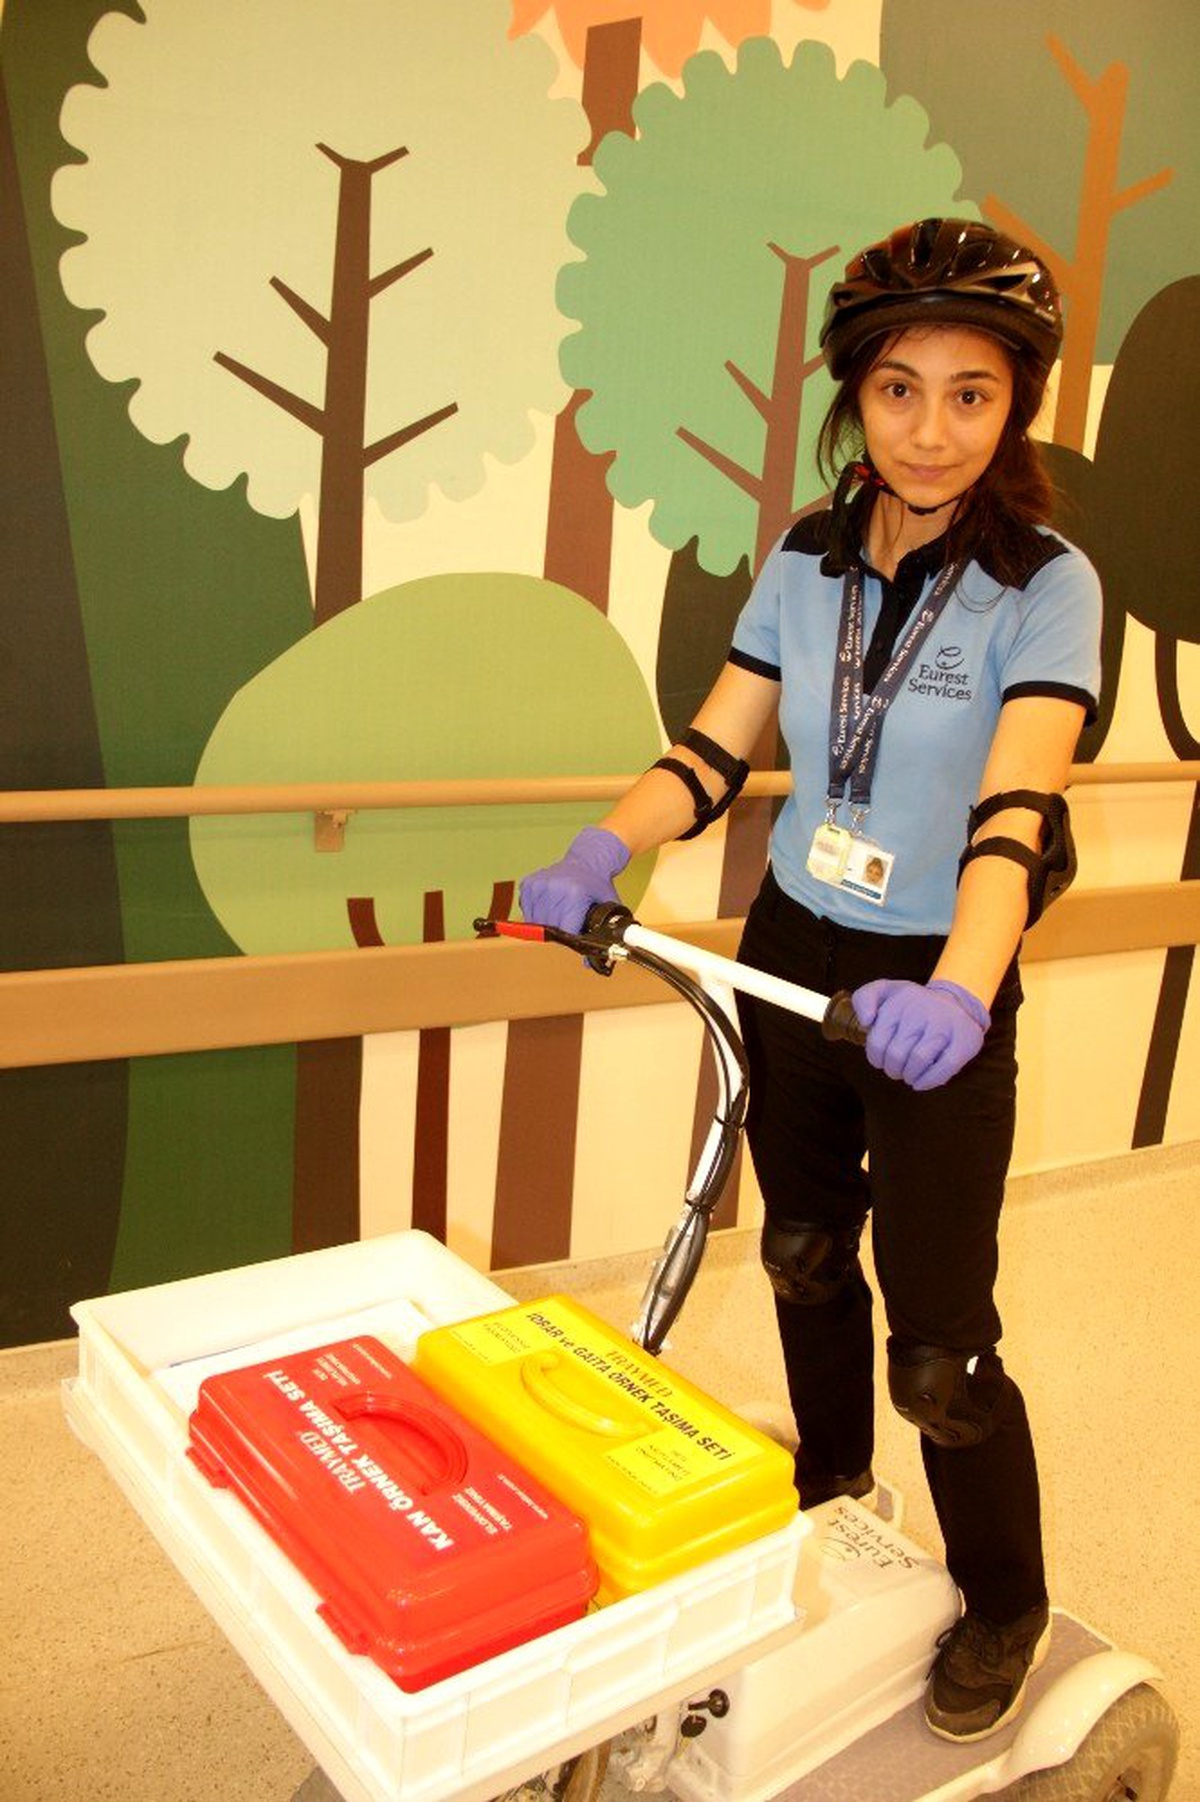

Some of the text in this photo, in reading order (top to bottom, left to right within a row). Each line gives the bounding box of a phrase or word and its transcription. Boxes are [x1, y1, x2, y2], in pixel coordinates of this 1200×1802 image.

[907, 679, 972, 700] Services
[919, 664, 970, 686] Eurest
[262, 1369, 306, 1401] SETİ
[560, 1337, 575, 1348] ve
[608, 1370, 654, 1403] ÖRNEK
[650, 1401, 700, 1439] TAŞIMA
[696, 1436, 736, 1460] SETİ
[299, 1400, 358, 1455] TAŞIMA
[298, 1431, 366, 1494] TRAYMED
[351, 1454, 414, 1510] ÖRNEK
[406, 1510, 454, 1550] KAN
[828, 1518, 893, 1569] Eurest
[834, 1506, 919, 1569] Services
